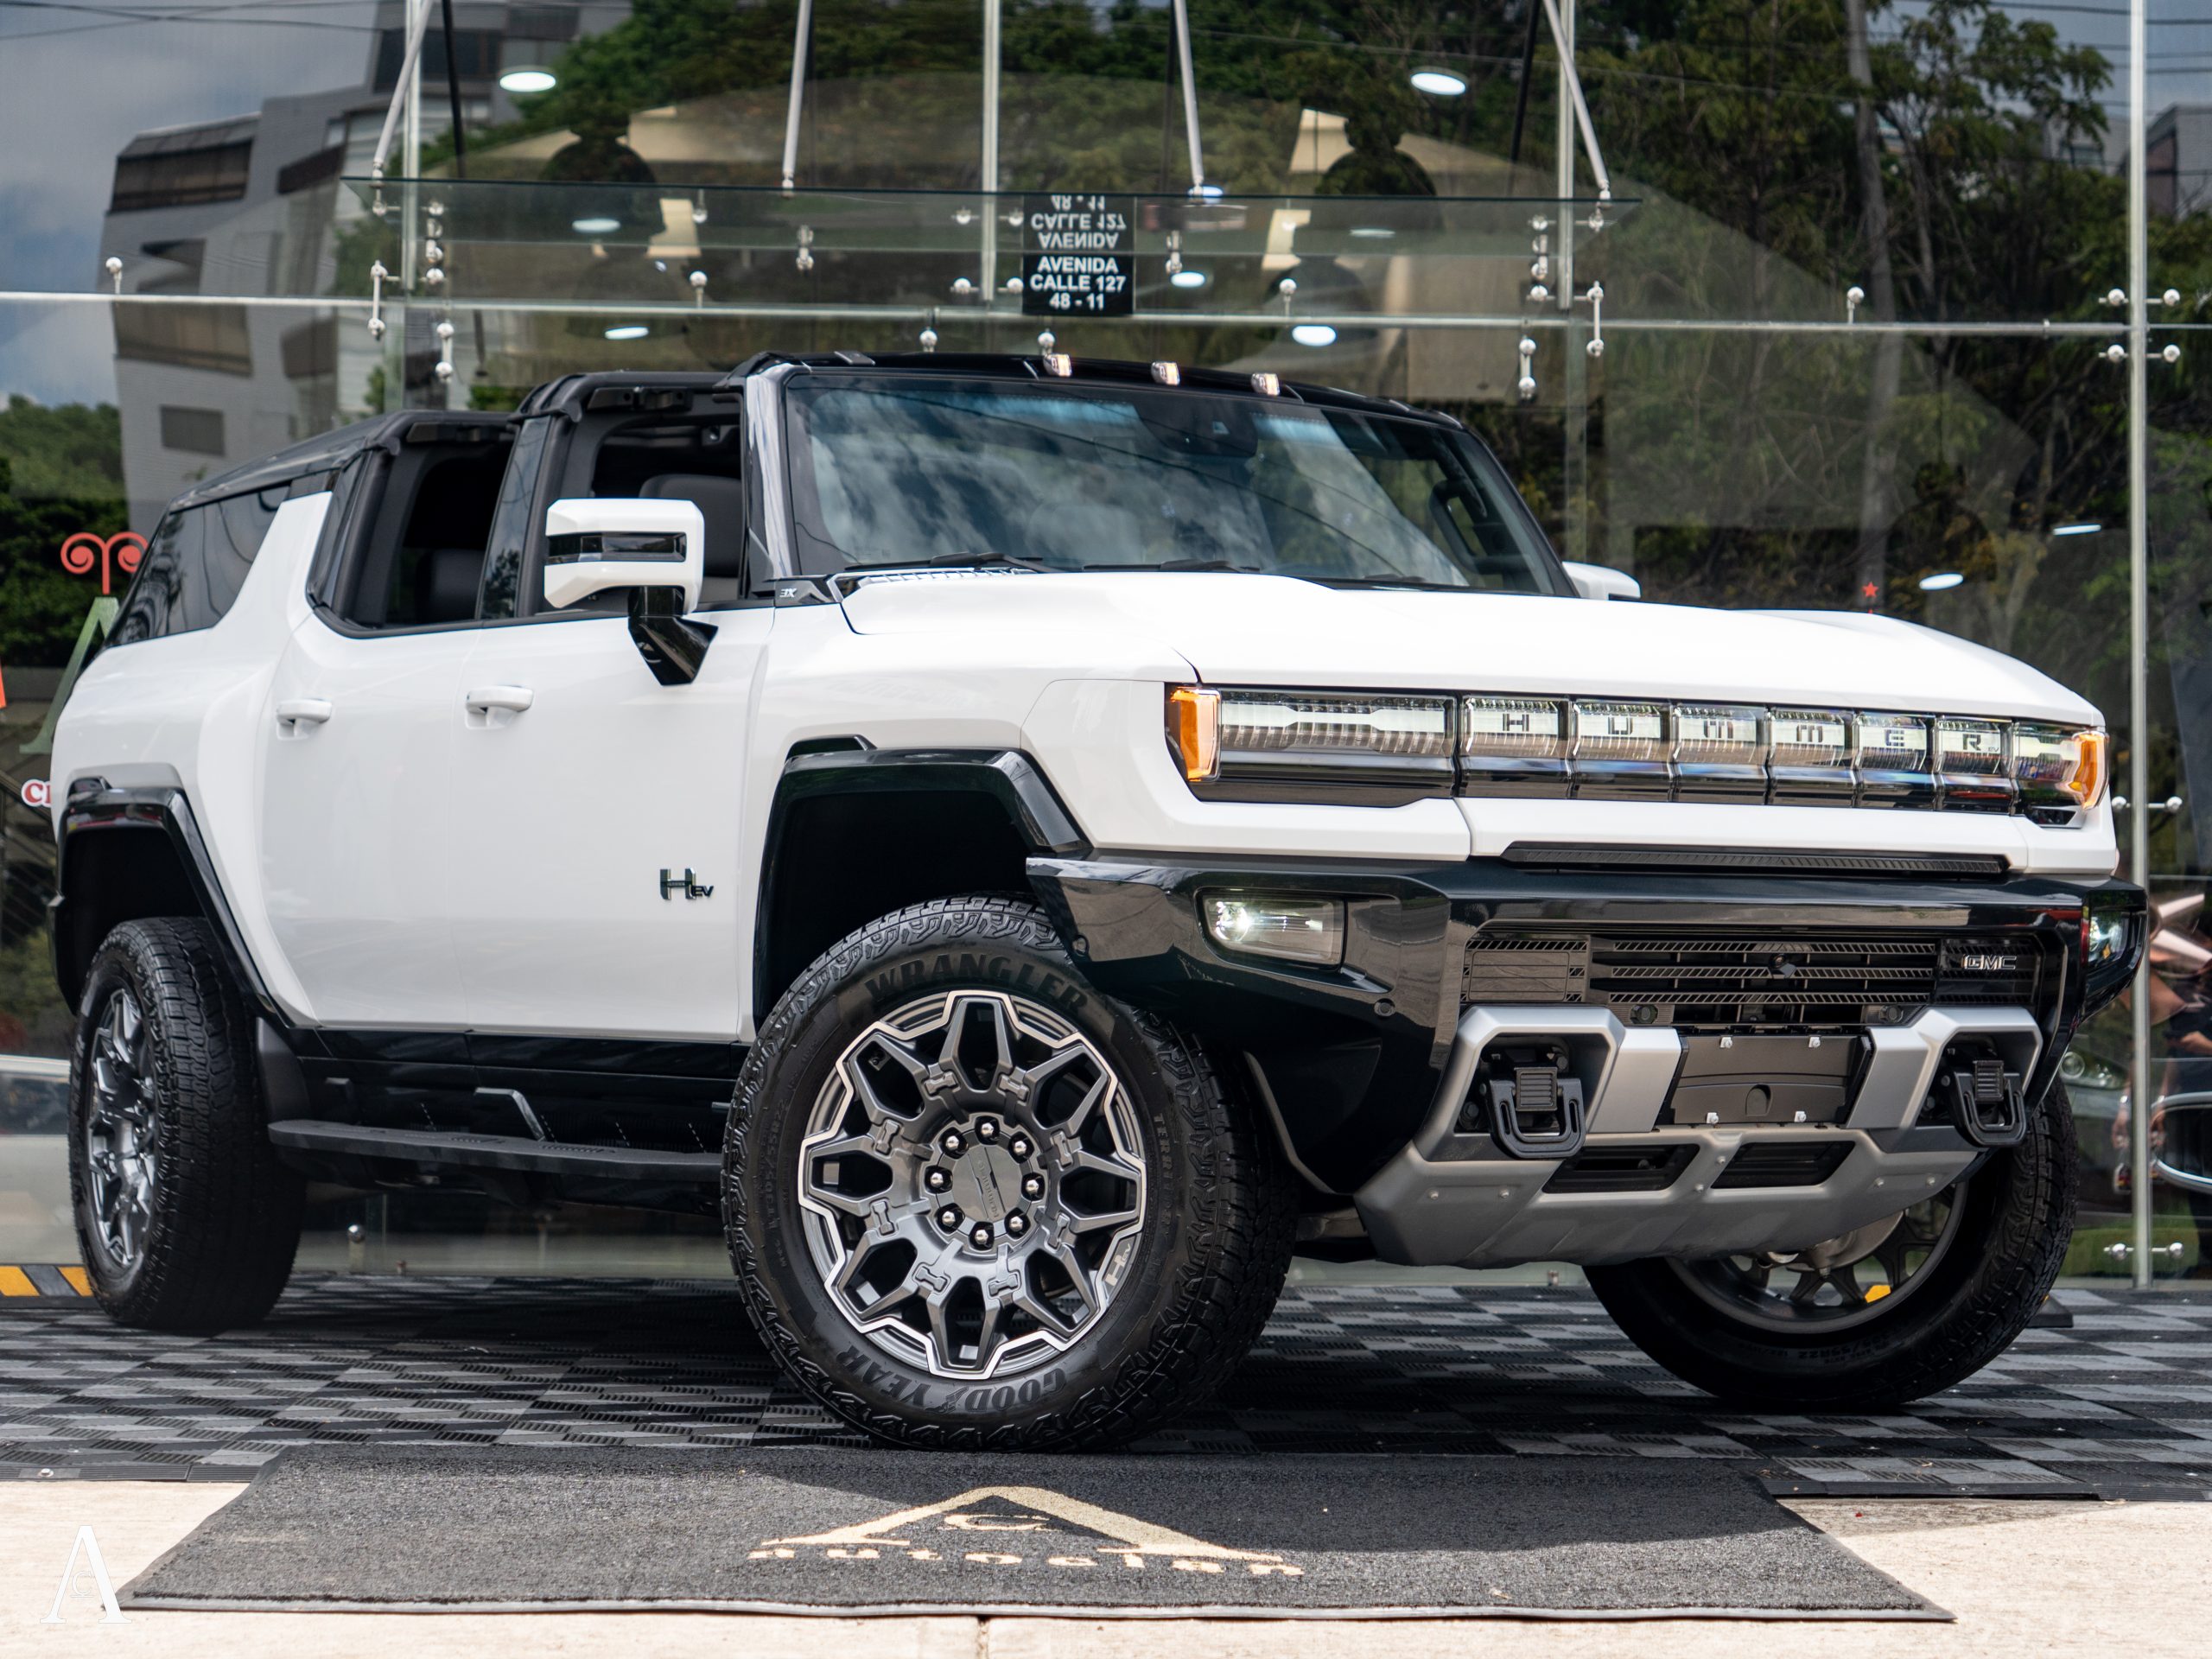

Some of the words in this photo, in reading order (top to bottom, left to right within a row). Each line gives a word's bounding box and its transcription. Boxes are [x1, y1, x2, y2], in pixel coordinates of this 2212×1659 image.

[1038, 256, 1119, 274] AVENIDA
[1030, 274, 1091, 291] CALLE
[1096, 276, 1127, 292] 127
[1049, 292, 1071, 309] 48
[1086, 293, 1105, 310] 11
[1502, 713, 1981, 752] HUMMER
[1961, 954, 2018, 970] GMC
[863, 953, 1090, 1011] WRANGLER
